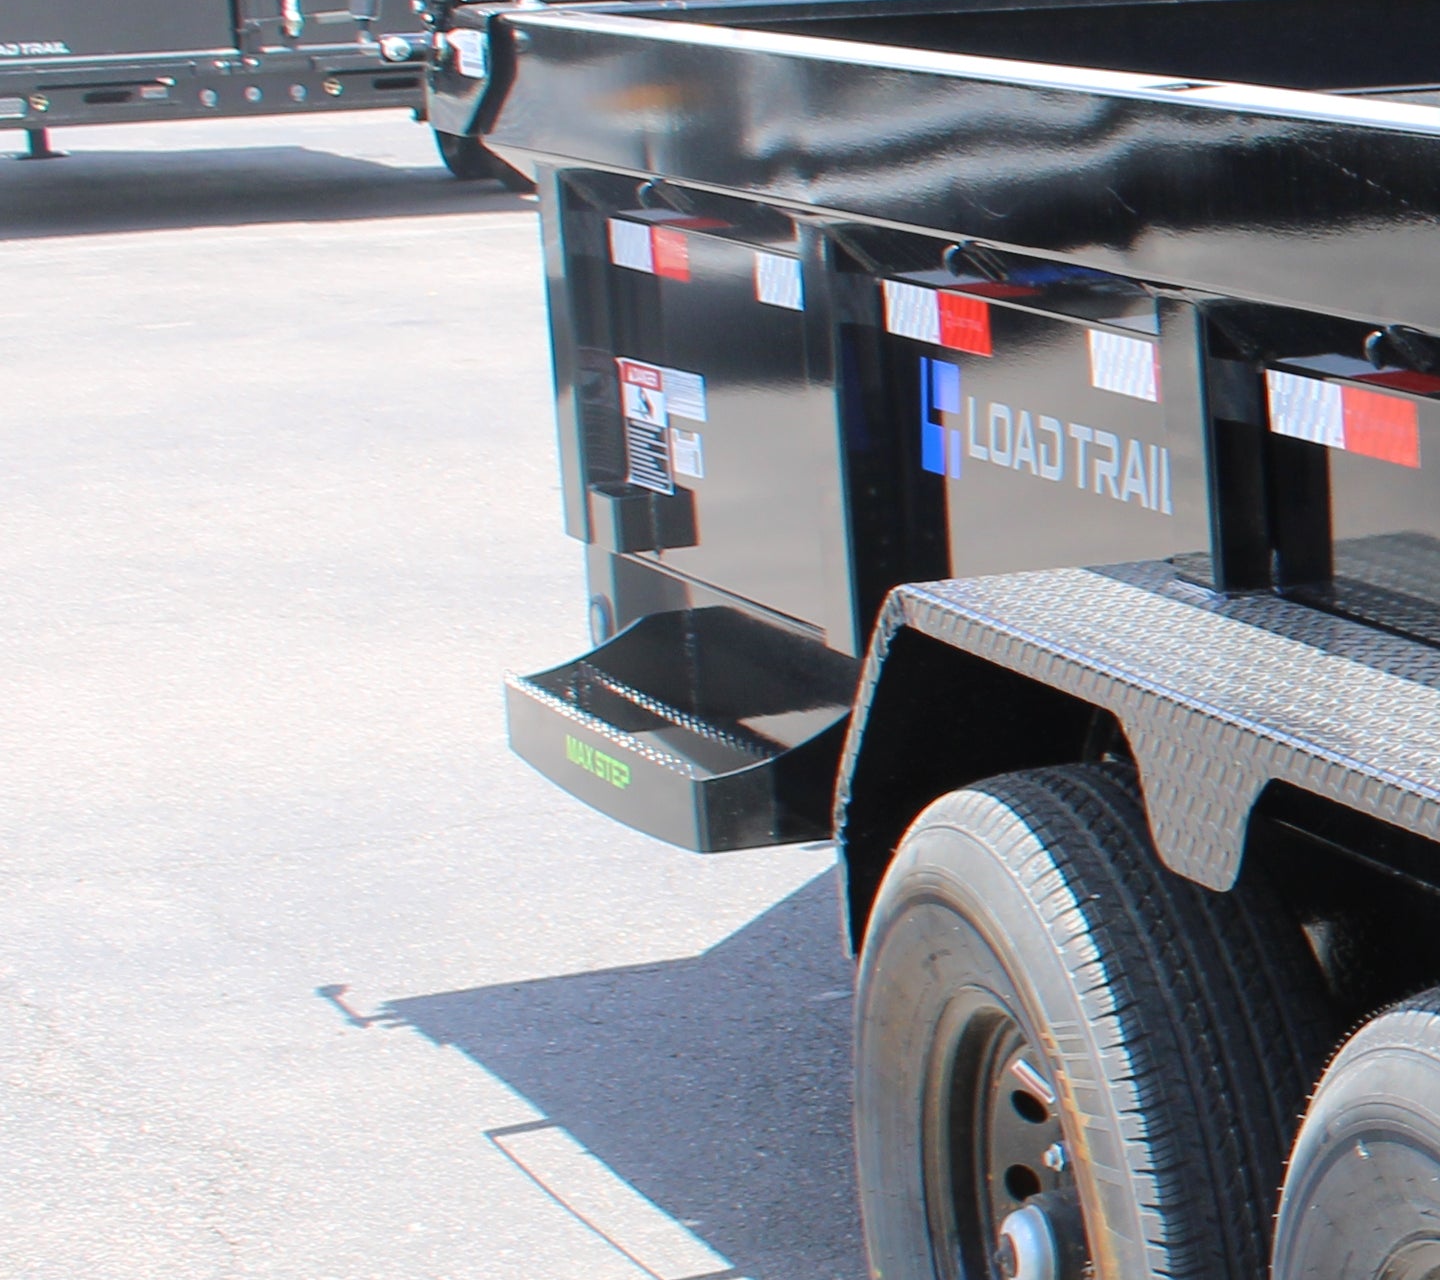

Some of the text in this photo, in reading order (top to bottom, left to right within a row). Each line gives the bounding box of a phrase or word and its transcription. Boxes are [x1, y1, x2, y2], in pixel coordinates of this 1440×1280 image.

[968, 396, 1174, 516] LOAD TRAIL
[565, 733, 632, 790] MAX STEP
